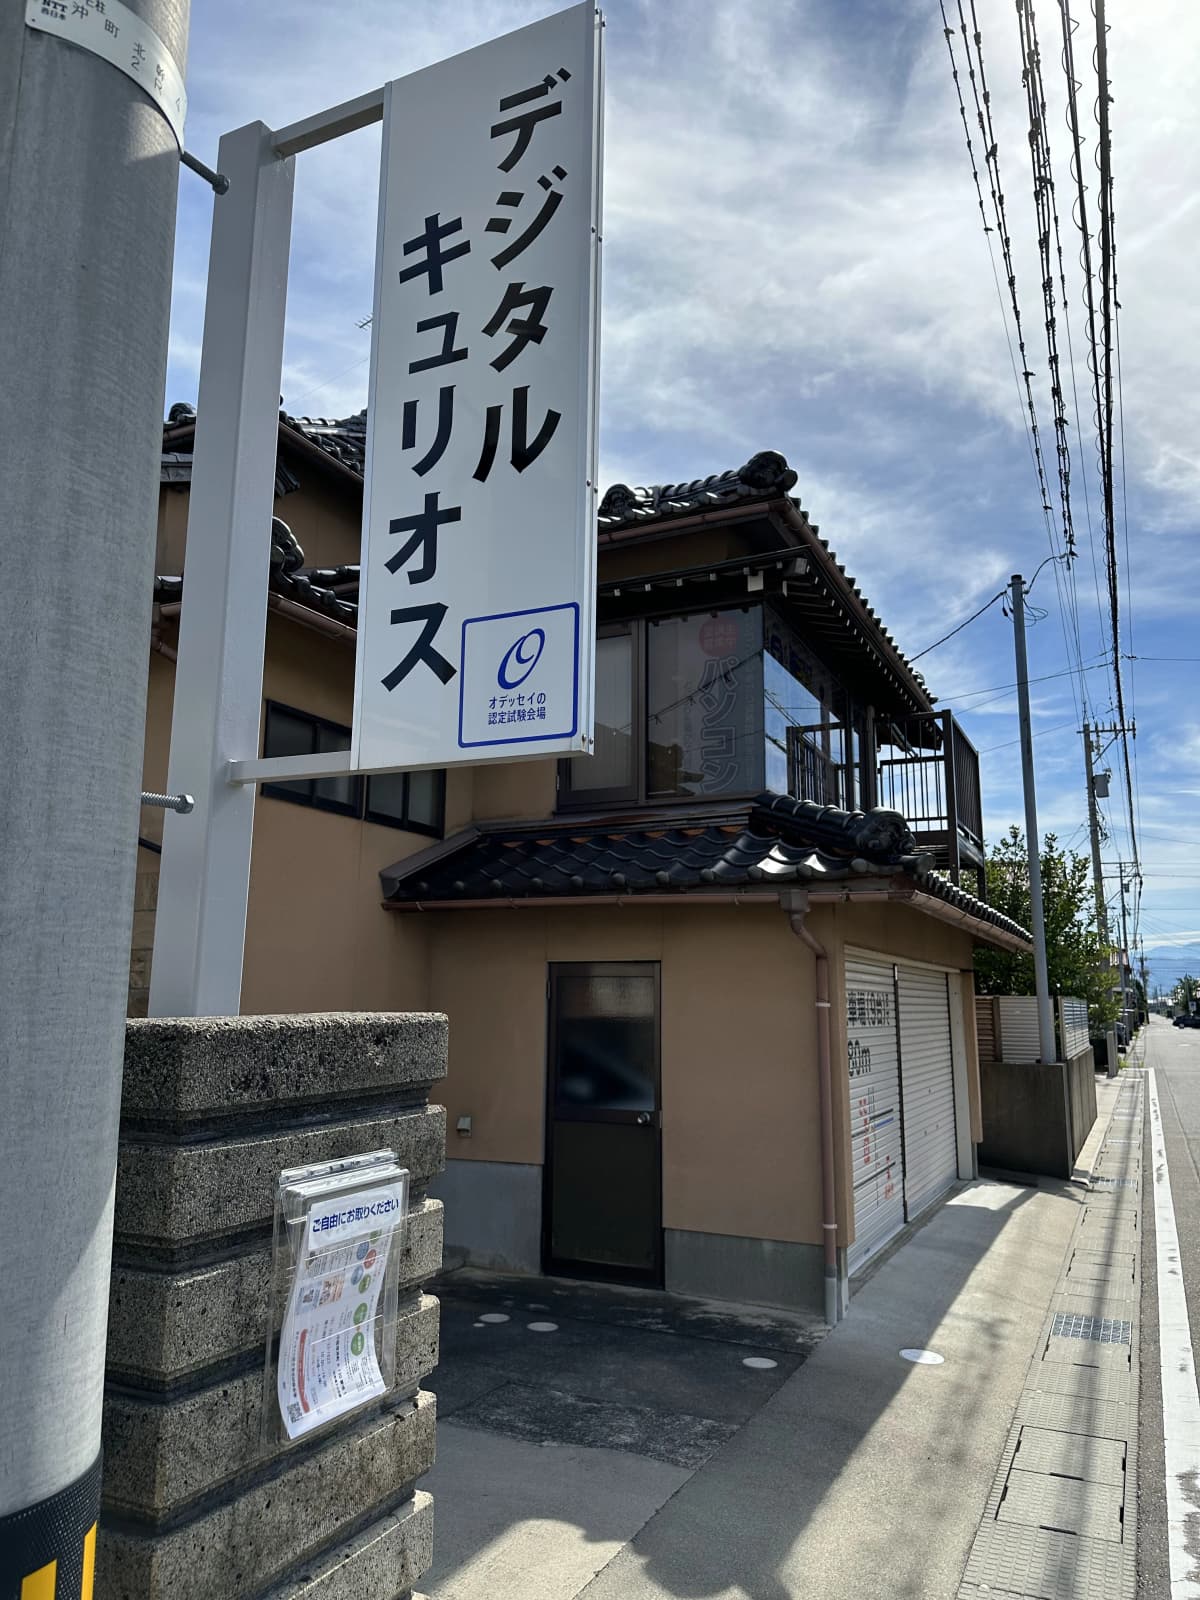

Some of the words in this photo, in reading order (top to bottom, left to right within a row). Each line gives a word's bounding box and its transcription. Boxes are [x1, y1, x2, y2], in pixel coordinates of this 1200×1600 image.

[472, 68, 571, 483] デジタル
[381, 212, 471, 693] キュリオス
[488, 692, 546, 710] オデッセイの
[488, 706, 546, 725] 認定試験会場
[697, 656, 740, 793] パソコン
[312, 1199, 399, 1232] ご自由にお取りください
